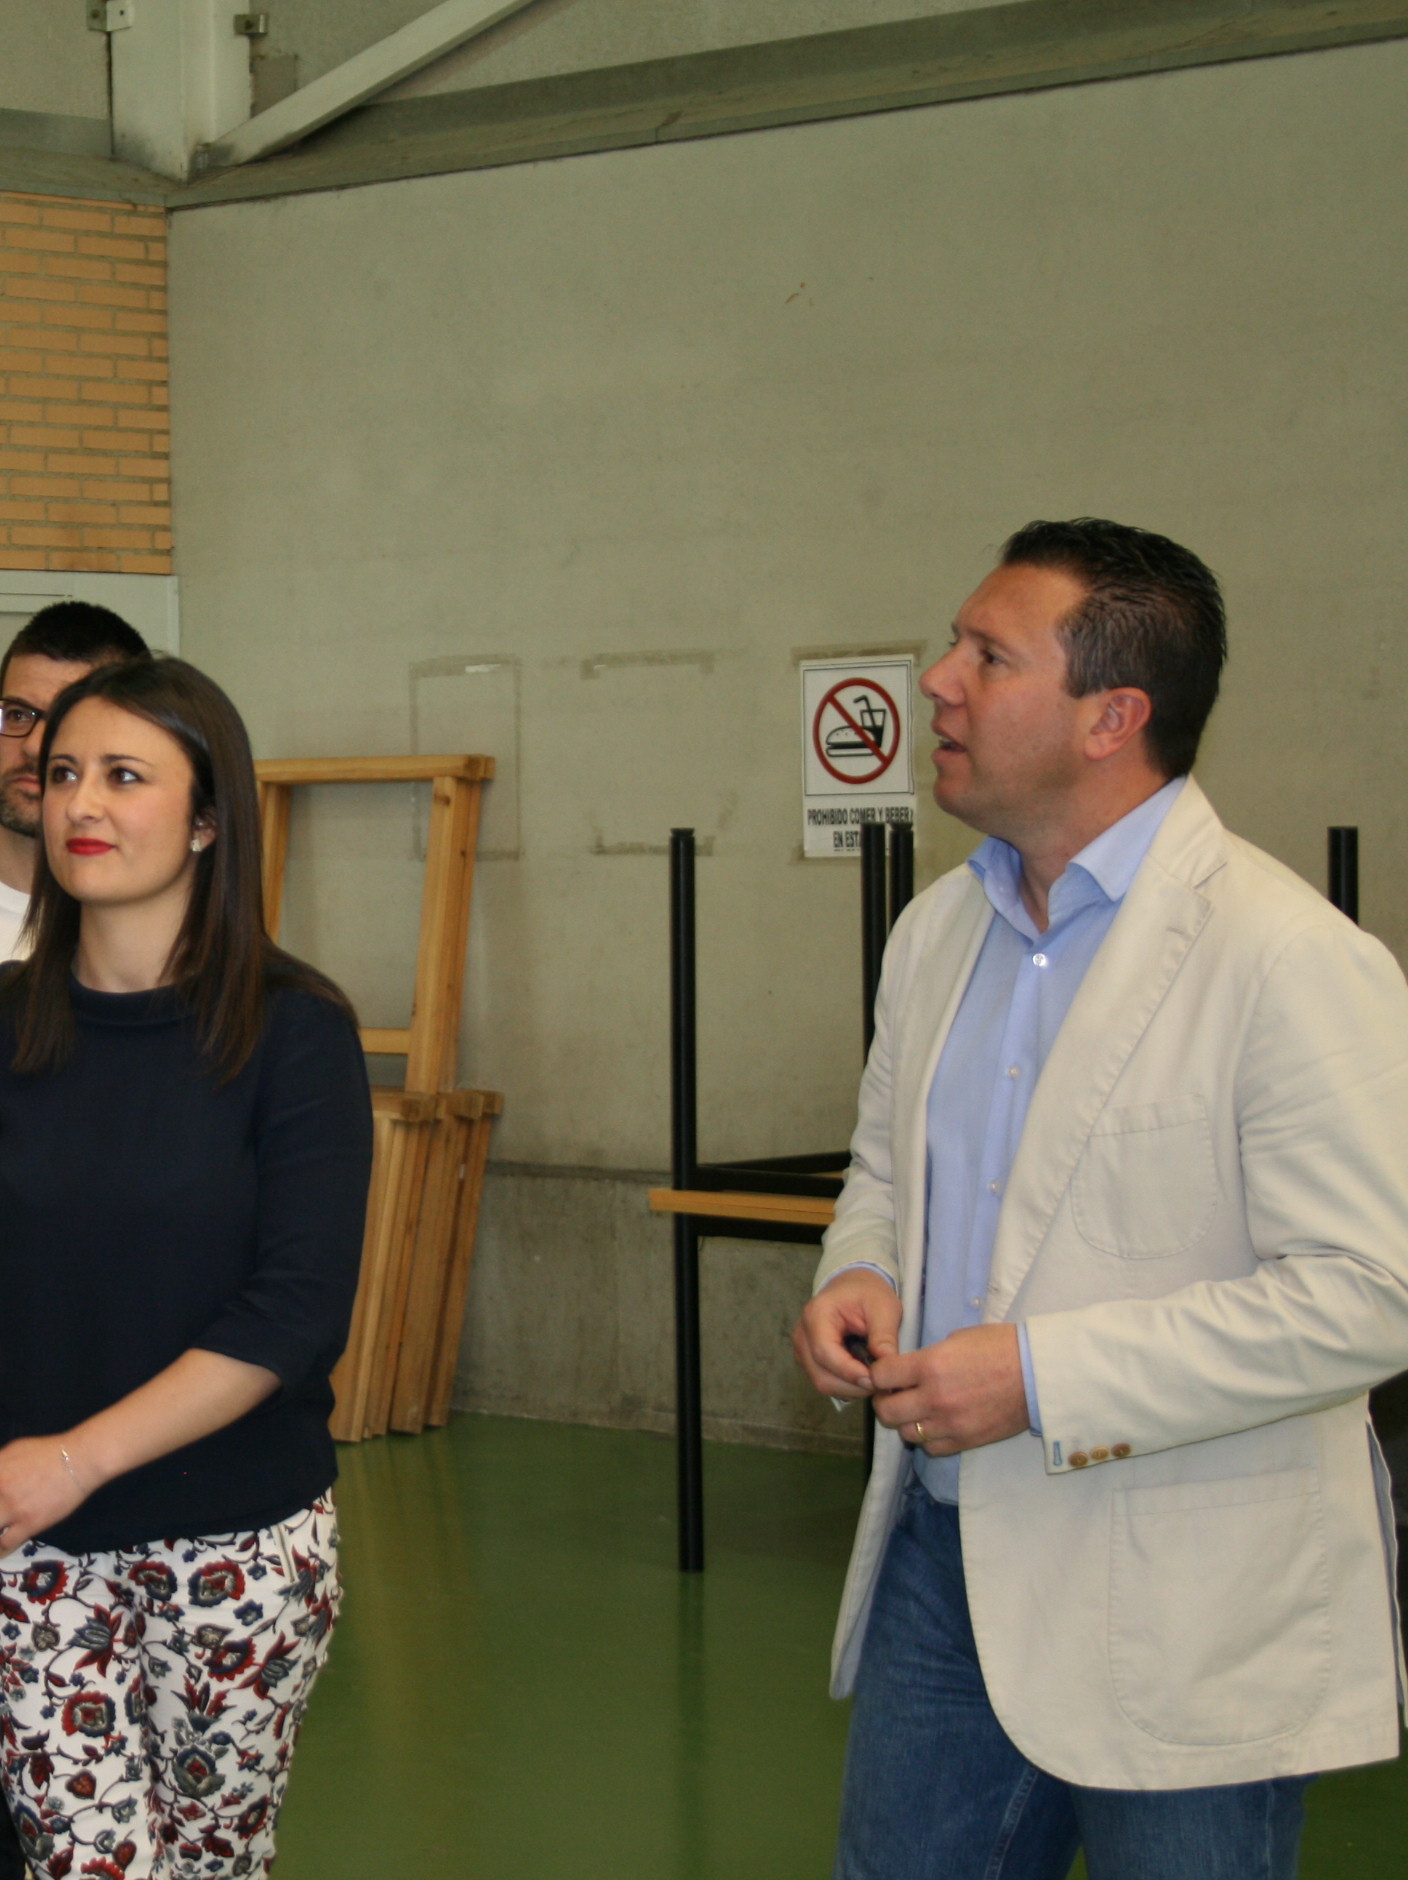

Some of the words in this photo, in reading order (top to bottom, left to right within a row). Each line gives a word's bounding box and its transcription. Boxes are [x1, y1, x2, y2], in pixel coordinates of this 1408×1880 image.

[807, 808, 848, 826] PROHIBIDO
[850, 807, 876, 825] COMER
[878, 807, 884, 822] Y
[885, 806, 909, 824] BEBER
[833, 830, 844, 848] EN
[845, 830, 862, 848] EST
